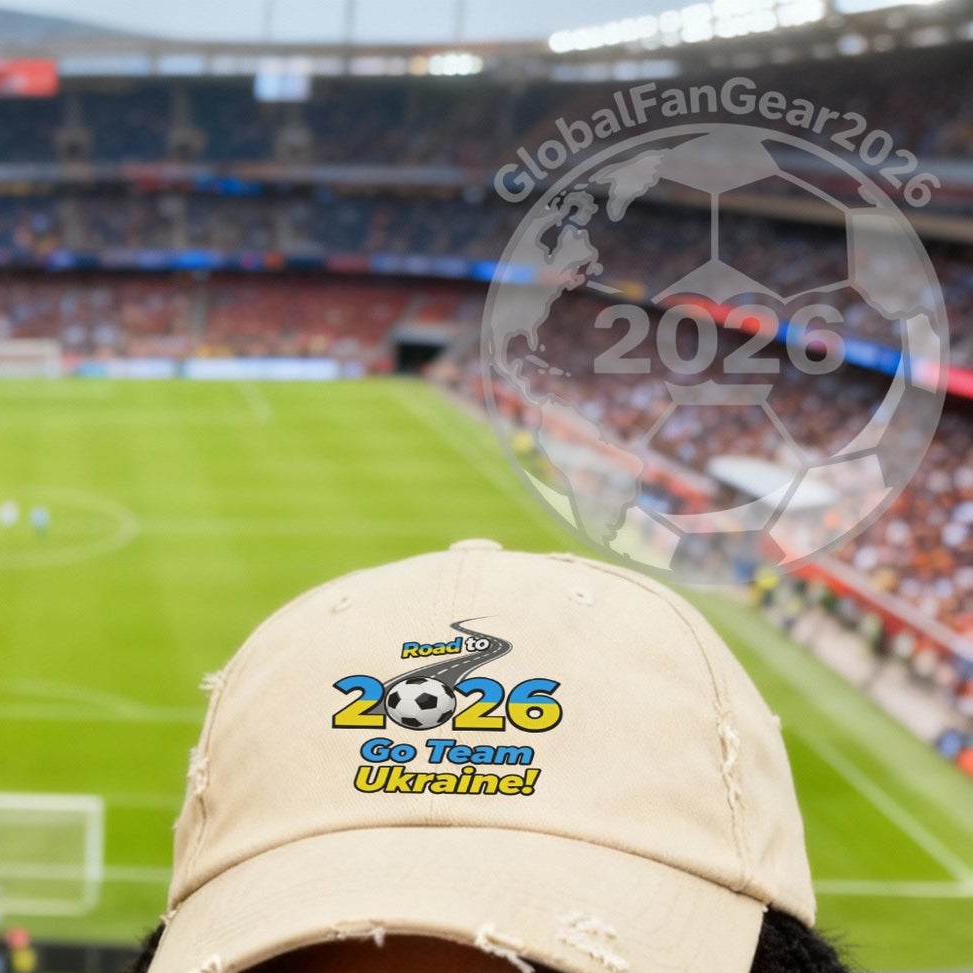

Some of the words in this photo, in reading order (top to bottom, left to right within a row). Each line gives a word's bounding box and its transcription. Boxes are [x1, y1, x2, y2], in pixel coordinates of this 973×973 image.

[401, 637, 463, 659] Road
[464, 636, 491, 651] to
[360, 737, 417, 763] Go
[425, 738, 535, 765] Team
[354, 765, 541, 796] Ukraine!
